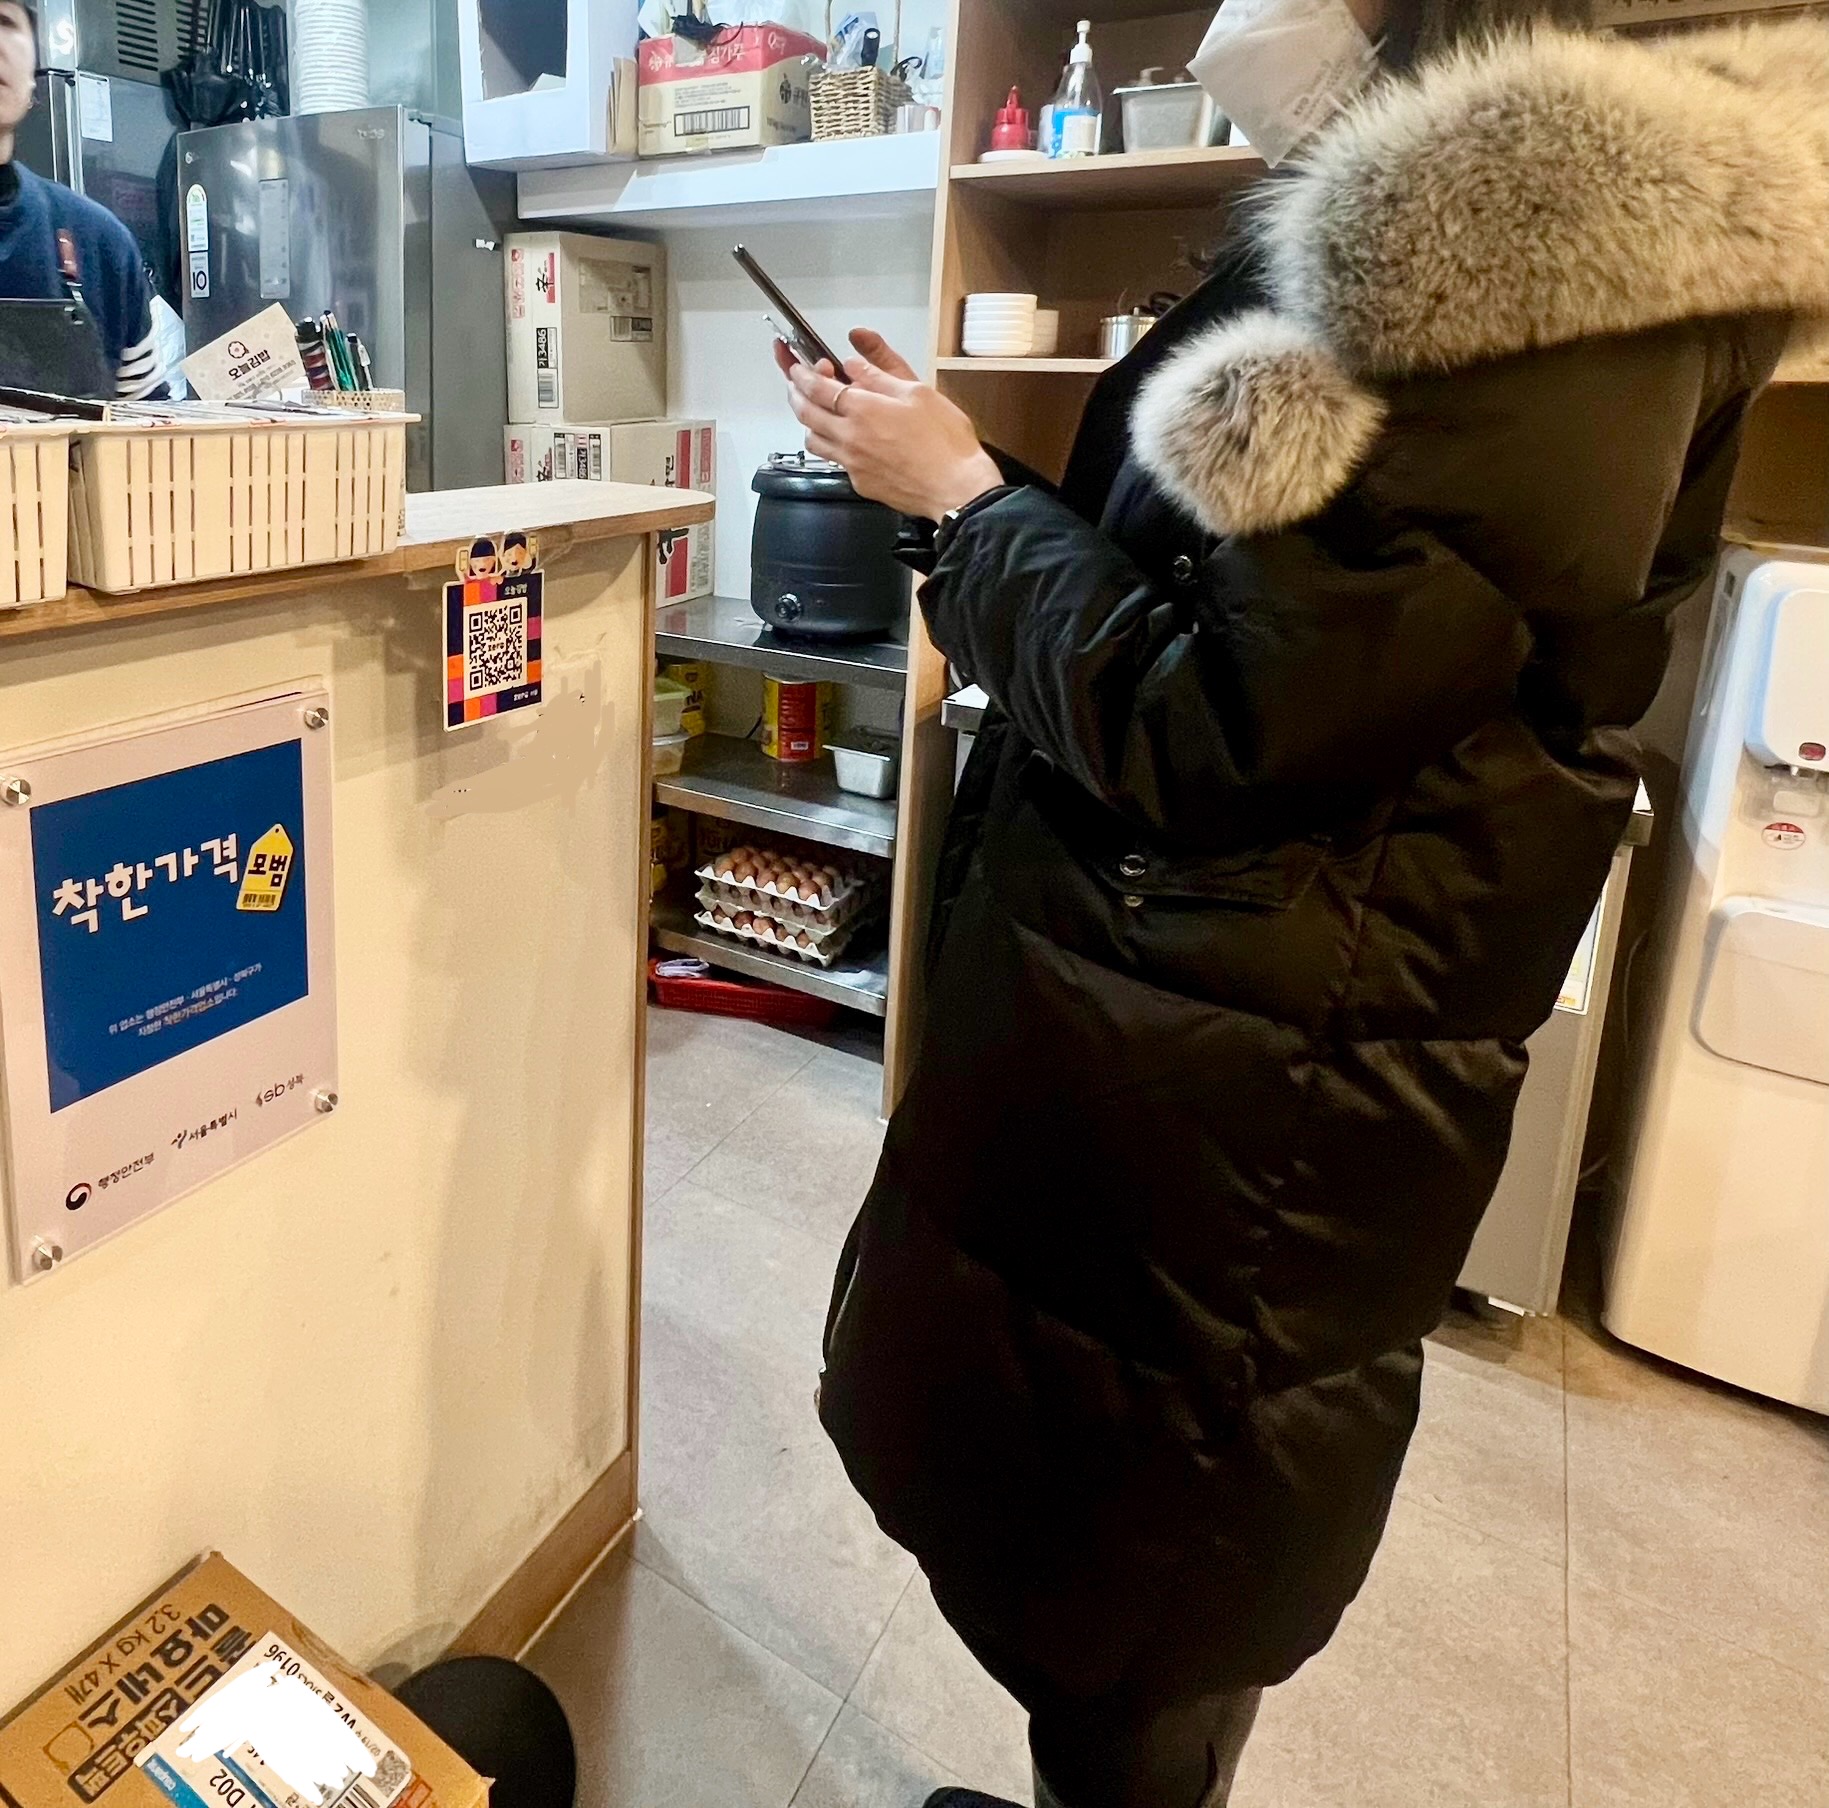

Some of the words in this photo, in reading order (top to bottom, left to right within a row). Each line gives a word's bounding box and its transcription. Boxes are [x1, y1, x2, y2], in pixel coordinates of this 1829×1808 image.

[228, 349, 271, 380] 오늘김밥
[53, 833, 239, 933] 착한가격
[248, 853, 288, 887] 모범
[189, 1108, 238, 1138] 서울특별시
[98, 1153, 154, 1190] 행정안전부
[144, 1603, 181, 1634] 3.2
[116, 1629, 150, 1656] kg
[64, 1670, 99, 1706] 4개
[209, 1768, 246, 1808] D02
